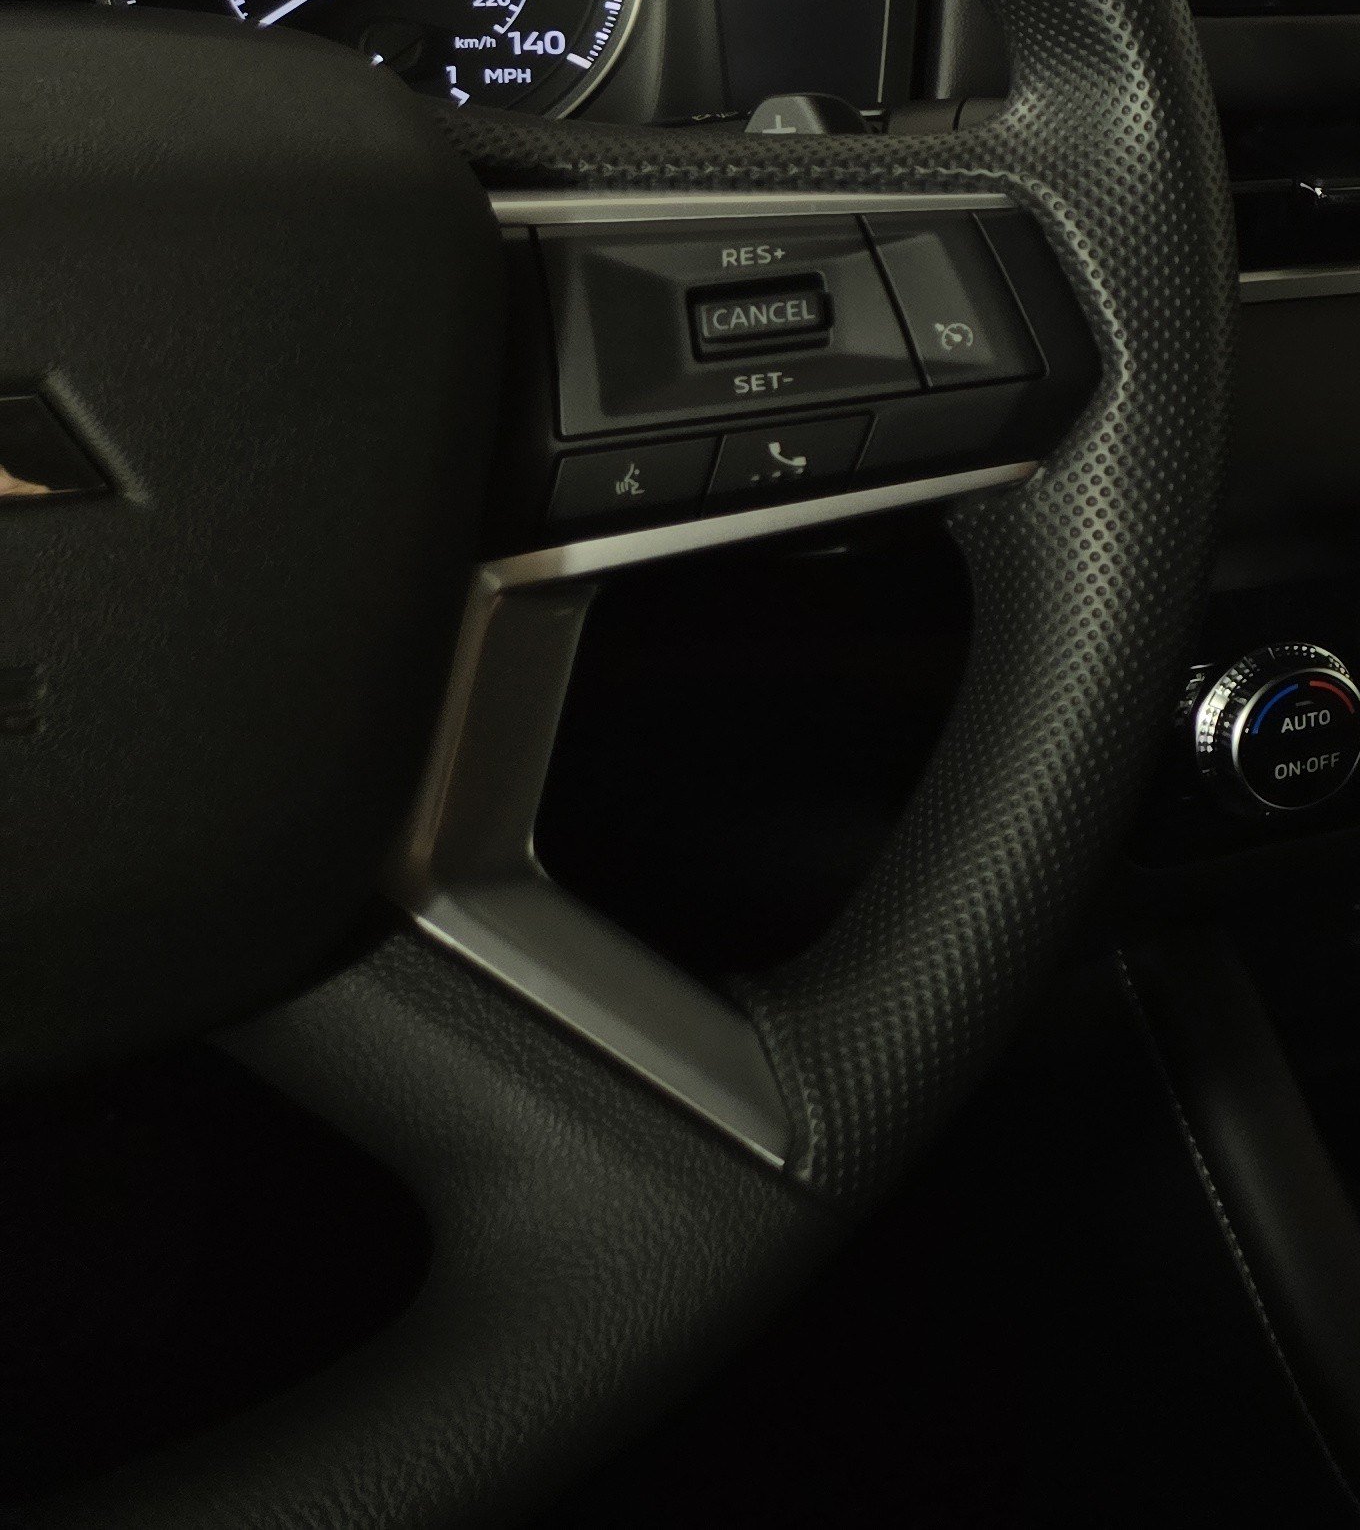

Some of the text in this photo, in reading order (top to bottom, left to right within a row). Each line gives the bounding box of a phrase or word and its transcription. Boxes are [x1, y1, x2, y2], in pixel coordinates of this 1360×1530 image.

[455, 35, 496, 50] km/h
[508, 31, 565, 56] 140
[485, 69, 531, 84] MPH
[722, 246, 786, 268] RES+
[713, 301, 815, 332] CANCEL
[734, 373, 793, 393] SET-
[1281, 710, 1330, 733] AUTO
